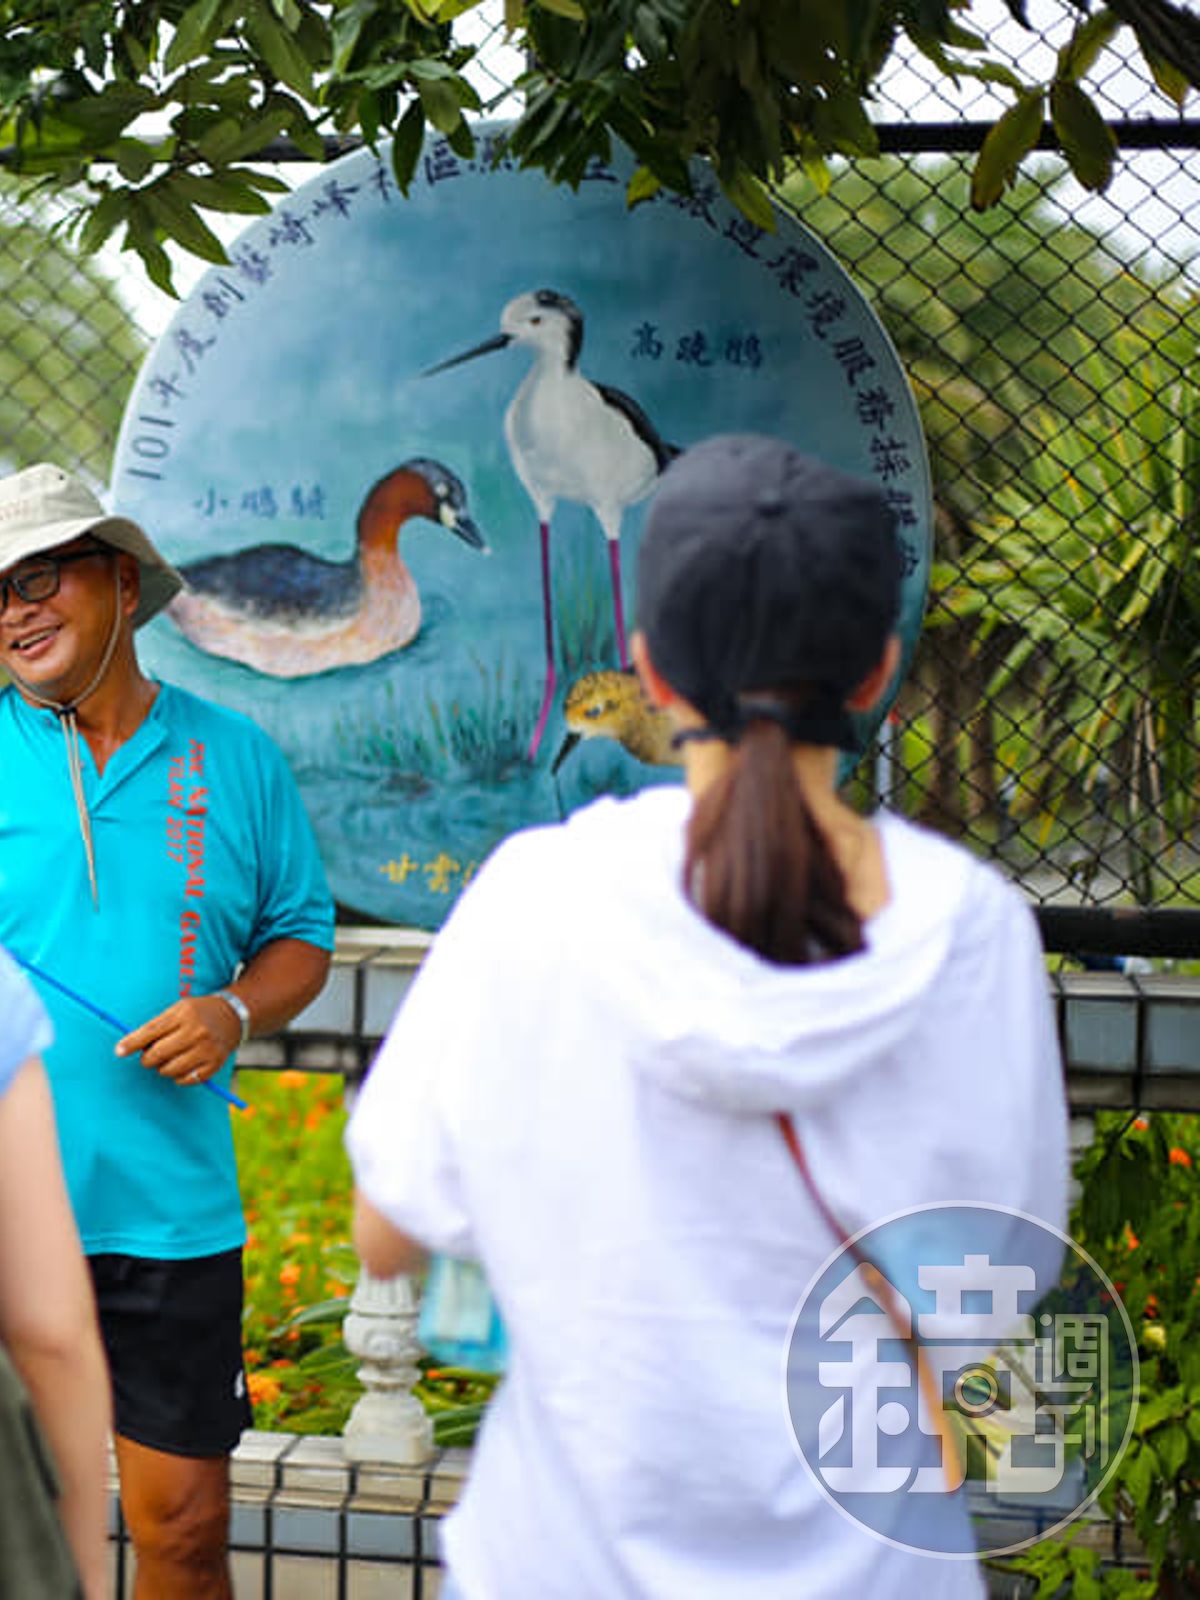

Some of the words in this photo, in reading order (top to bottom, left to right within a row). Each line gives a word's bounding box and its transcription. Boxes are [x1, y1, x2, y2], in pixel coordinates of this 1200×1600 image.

[168, 756, 185, 808] YILAN
[166, 816, 183, 863] 2017
[185, 786, 208, 901] NATIONAL
